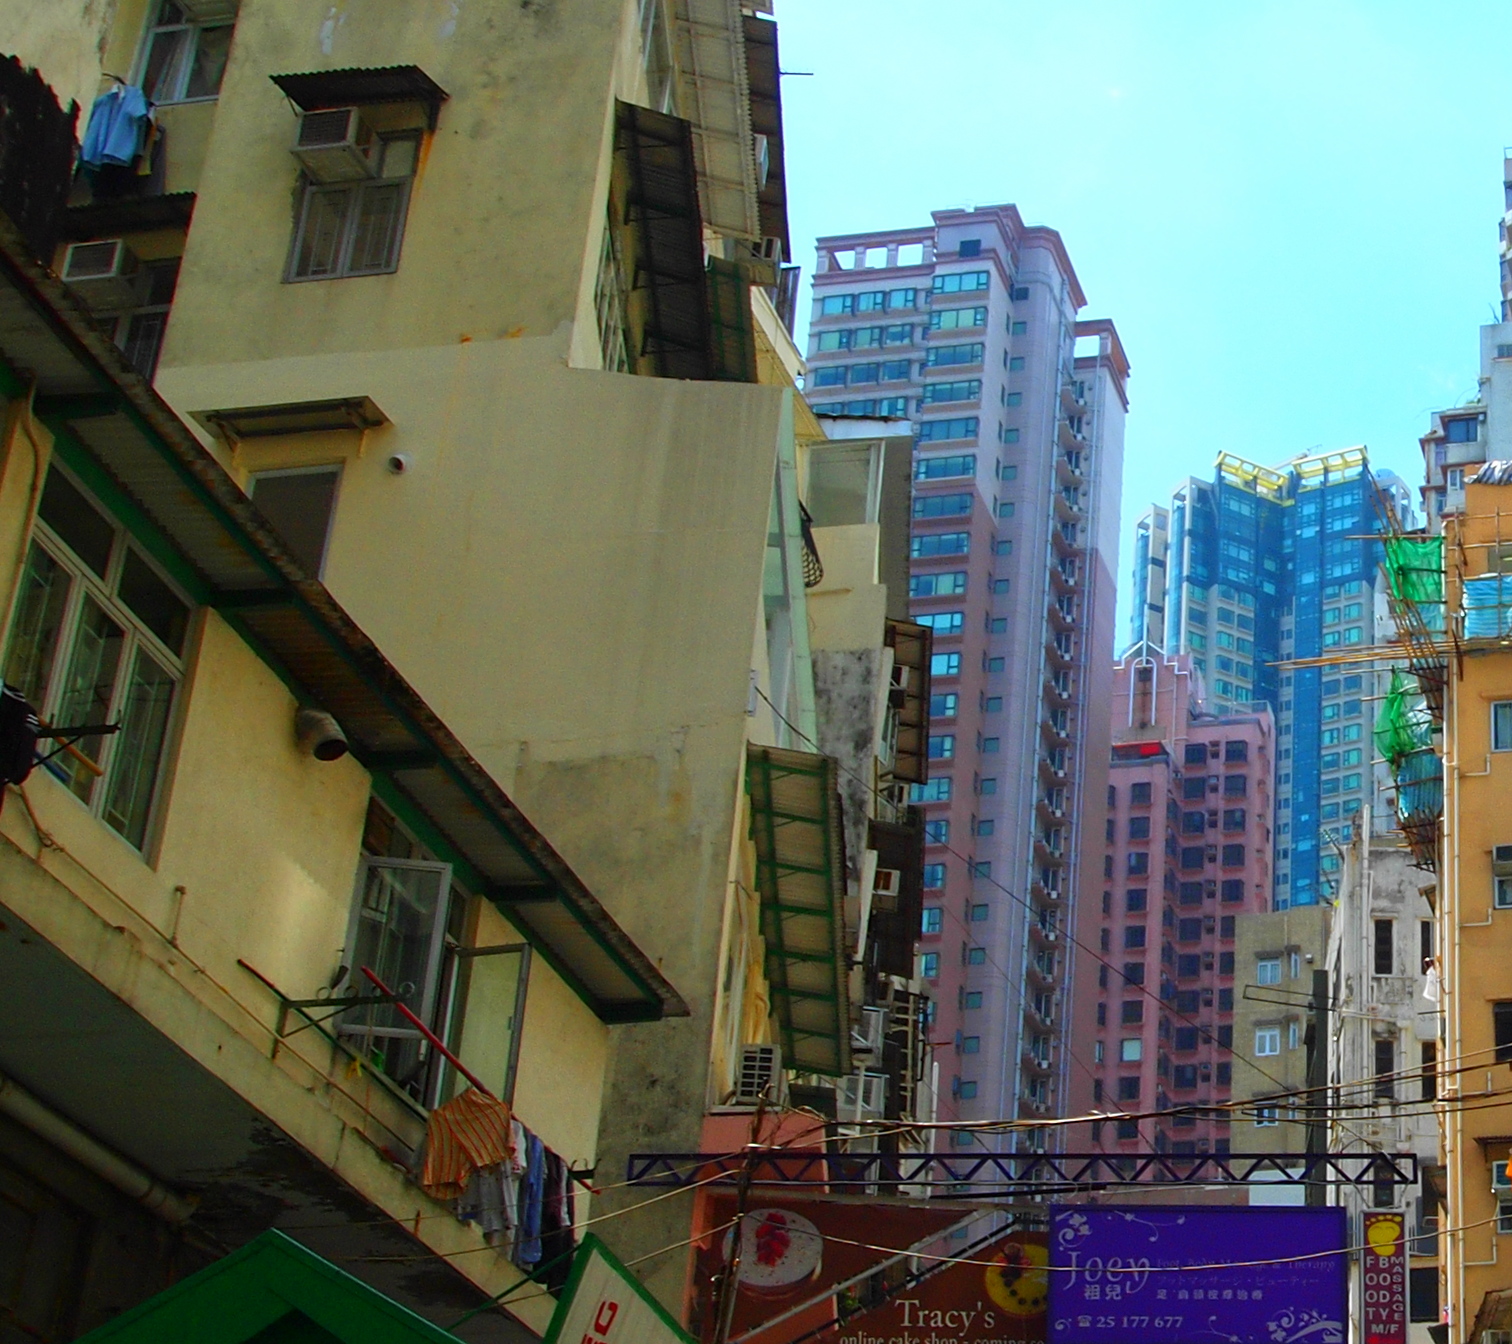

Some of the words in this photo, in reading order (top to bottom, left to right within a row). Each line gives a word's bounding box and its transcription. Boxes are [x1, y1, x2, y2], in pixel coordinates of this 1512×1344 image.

[1063, 1251, 1150, 1294] Joey
[1083, 1283, 1123, 1301] 祖兒
[1391, 1256, 1404, 1321] MASSAGE
[895, 1299, 995, 1337] Tracy's
[1096, 1315, 1116, 1329] 25
[1122, 1315, 1150, 1329] 177
[1154, 1315, 1184, 1329] 677
[1371, 1323, 1399, 1334] M/F
